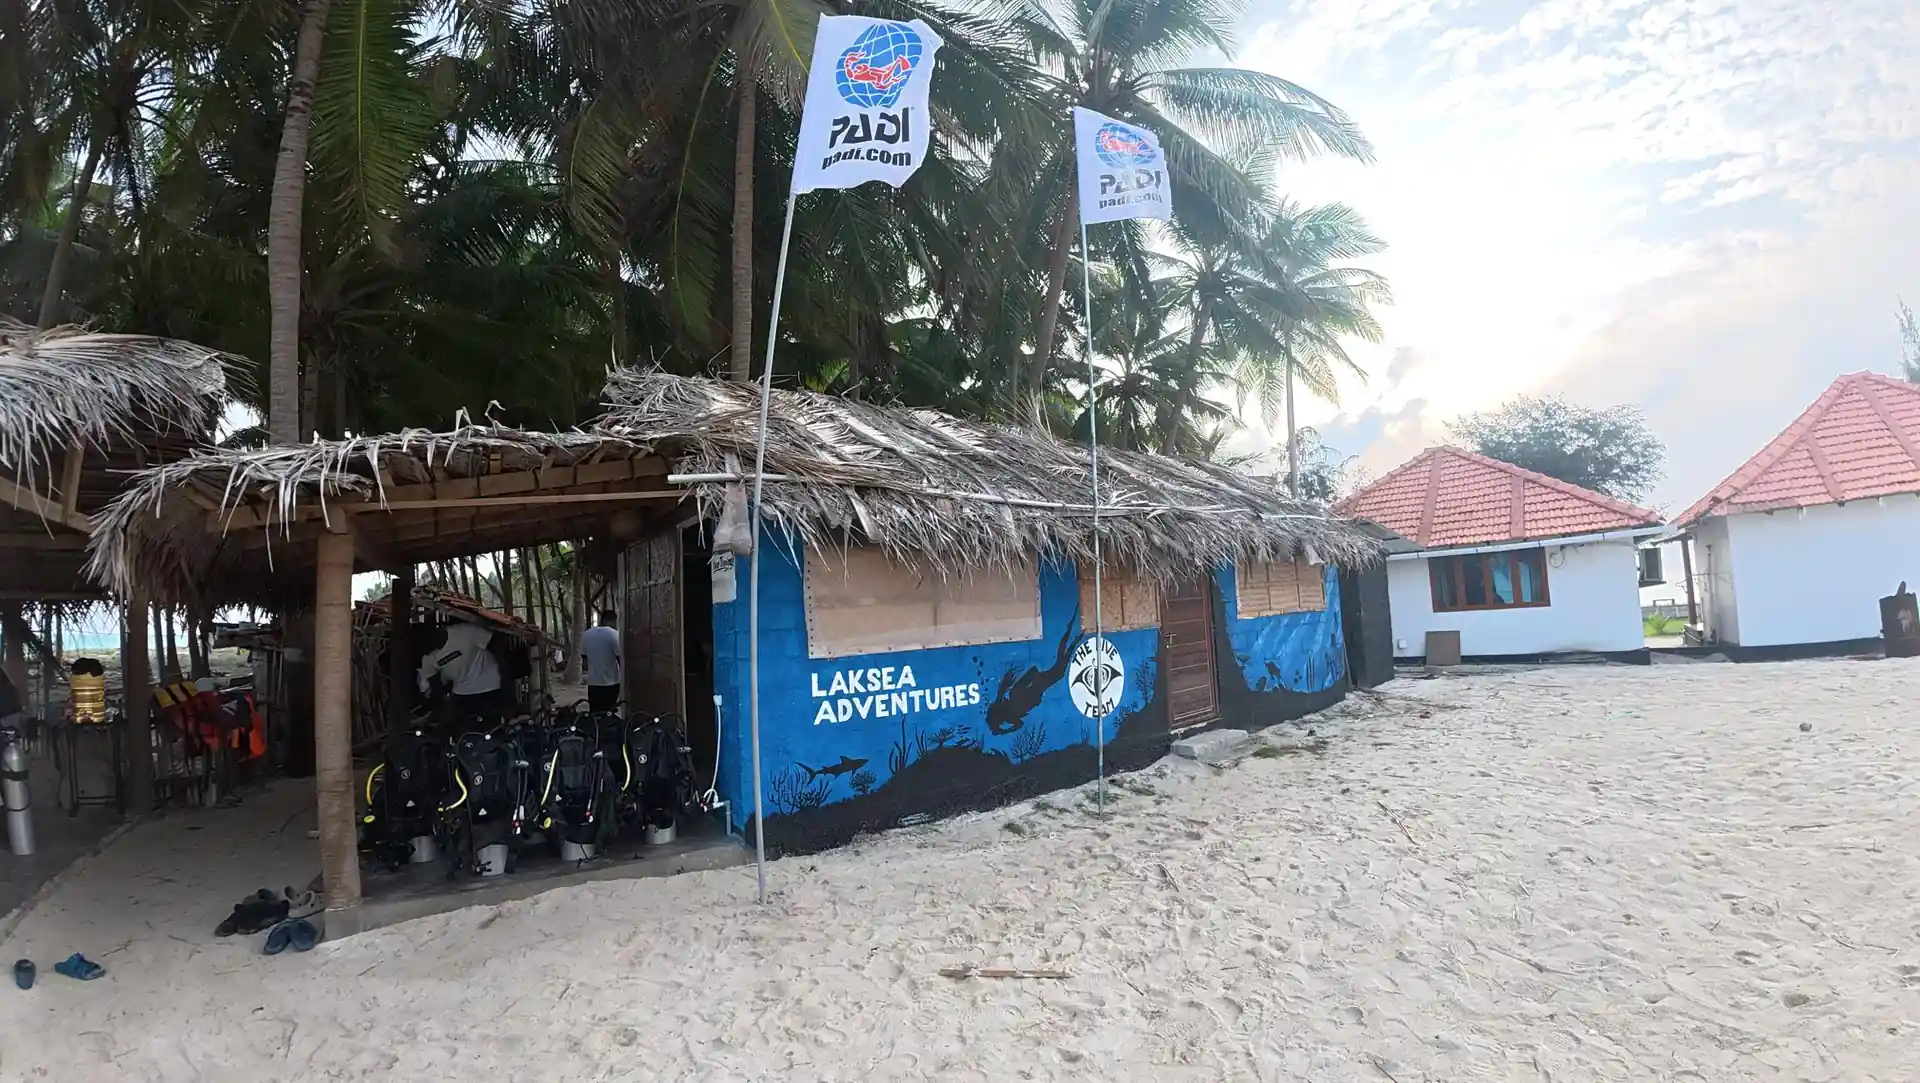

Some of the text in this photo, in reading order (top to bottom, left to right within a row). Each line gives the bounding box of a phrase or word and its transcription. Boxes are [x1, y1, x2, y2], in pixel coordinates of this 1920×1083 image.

[829, 107, 910, 149] PADI
[821, 148, 912, 170] padi.com
[1099, 168, 1162, 195] PADI
[1099, 193, 1162, 209] padi.com
[1072, 638, 1118, 667] THE IVE
[811, 665, 917, 698] LAKSEA
[813, 683, 981, 726] ADVENTURES
[1084, 697, 1115, 718] TEAM
